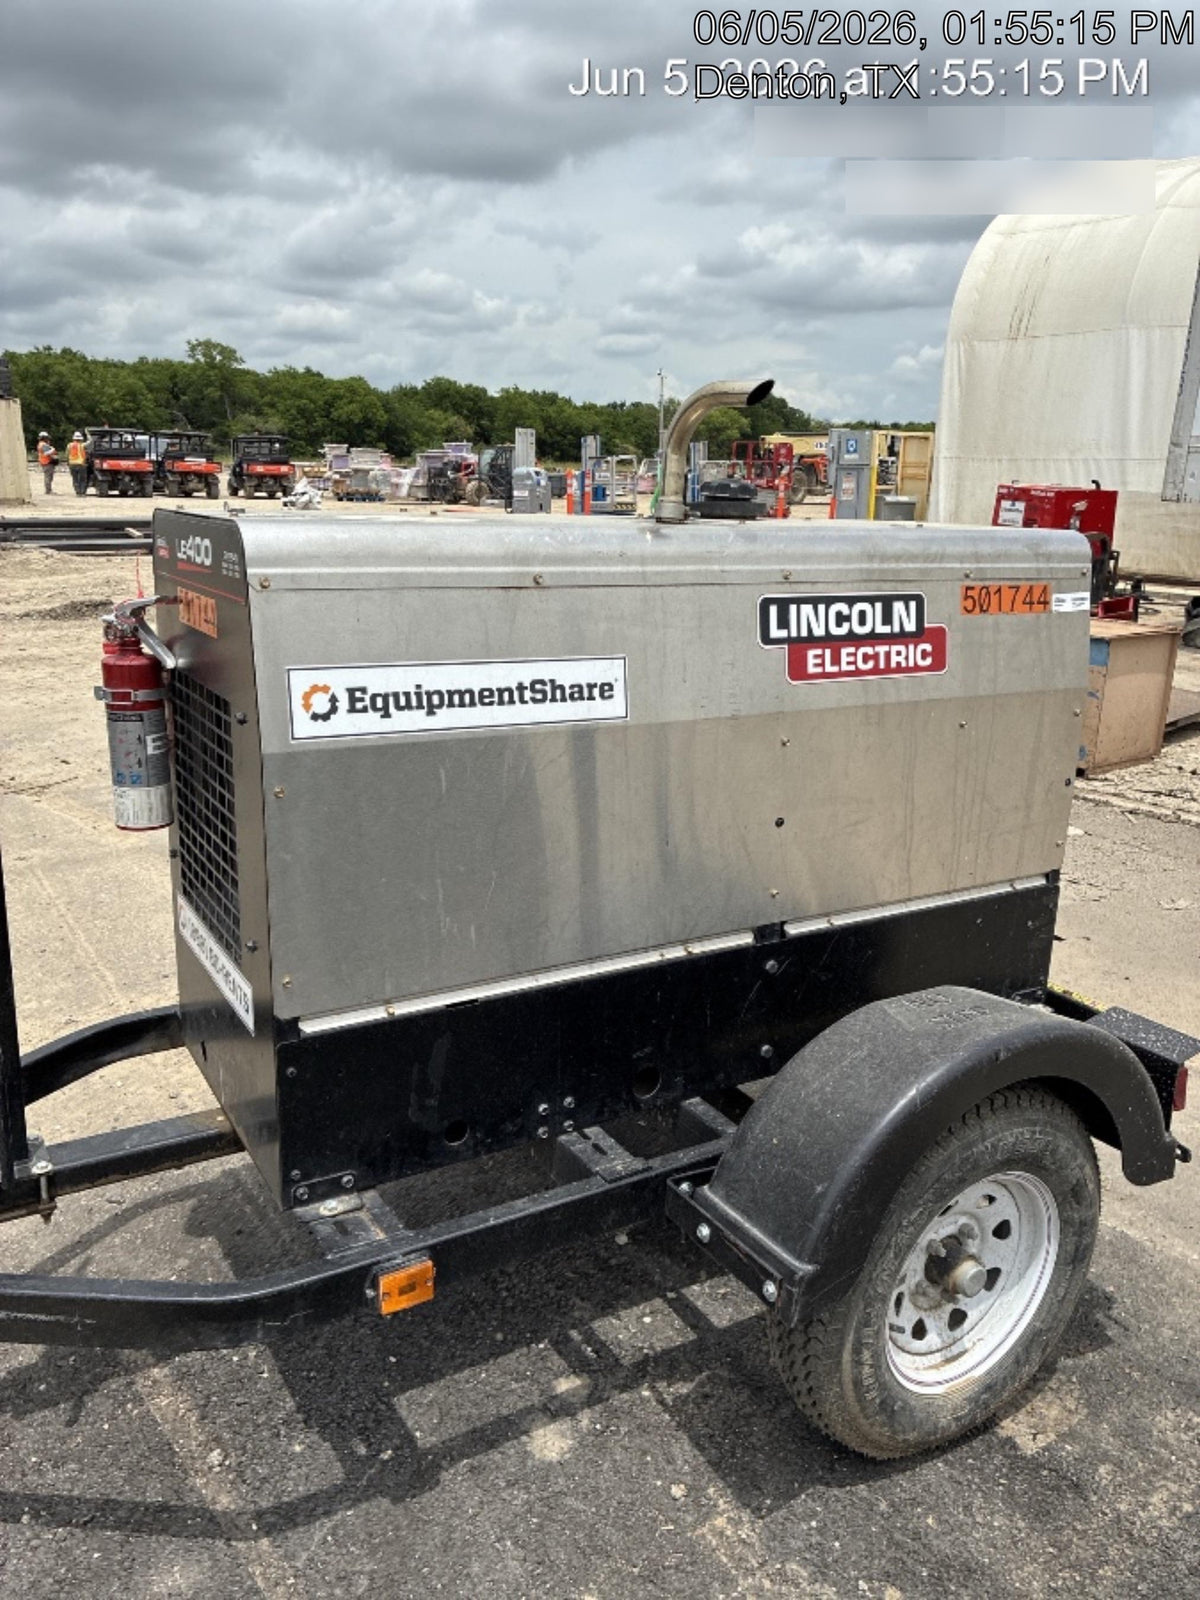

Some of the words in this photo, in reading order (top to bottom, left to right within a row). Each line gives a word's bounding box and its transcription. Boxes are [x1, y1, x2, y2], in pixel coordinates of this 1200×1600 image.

[962, 584, 1050, 614] 501744
[769, 600, 917, 639] LINCOLN
[806, 643, 933, 674] ELECTRIC
[345, 678, 615, 719] EquipmentShare
